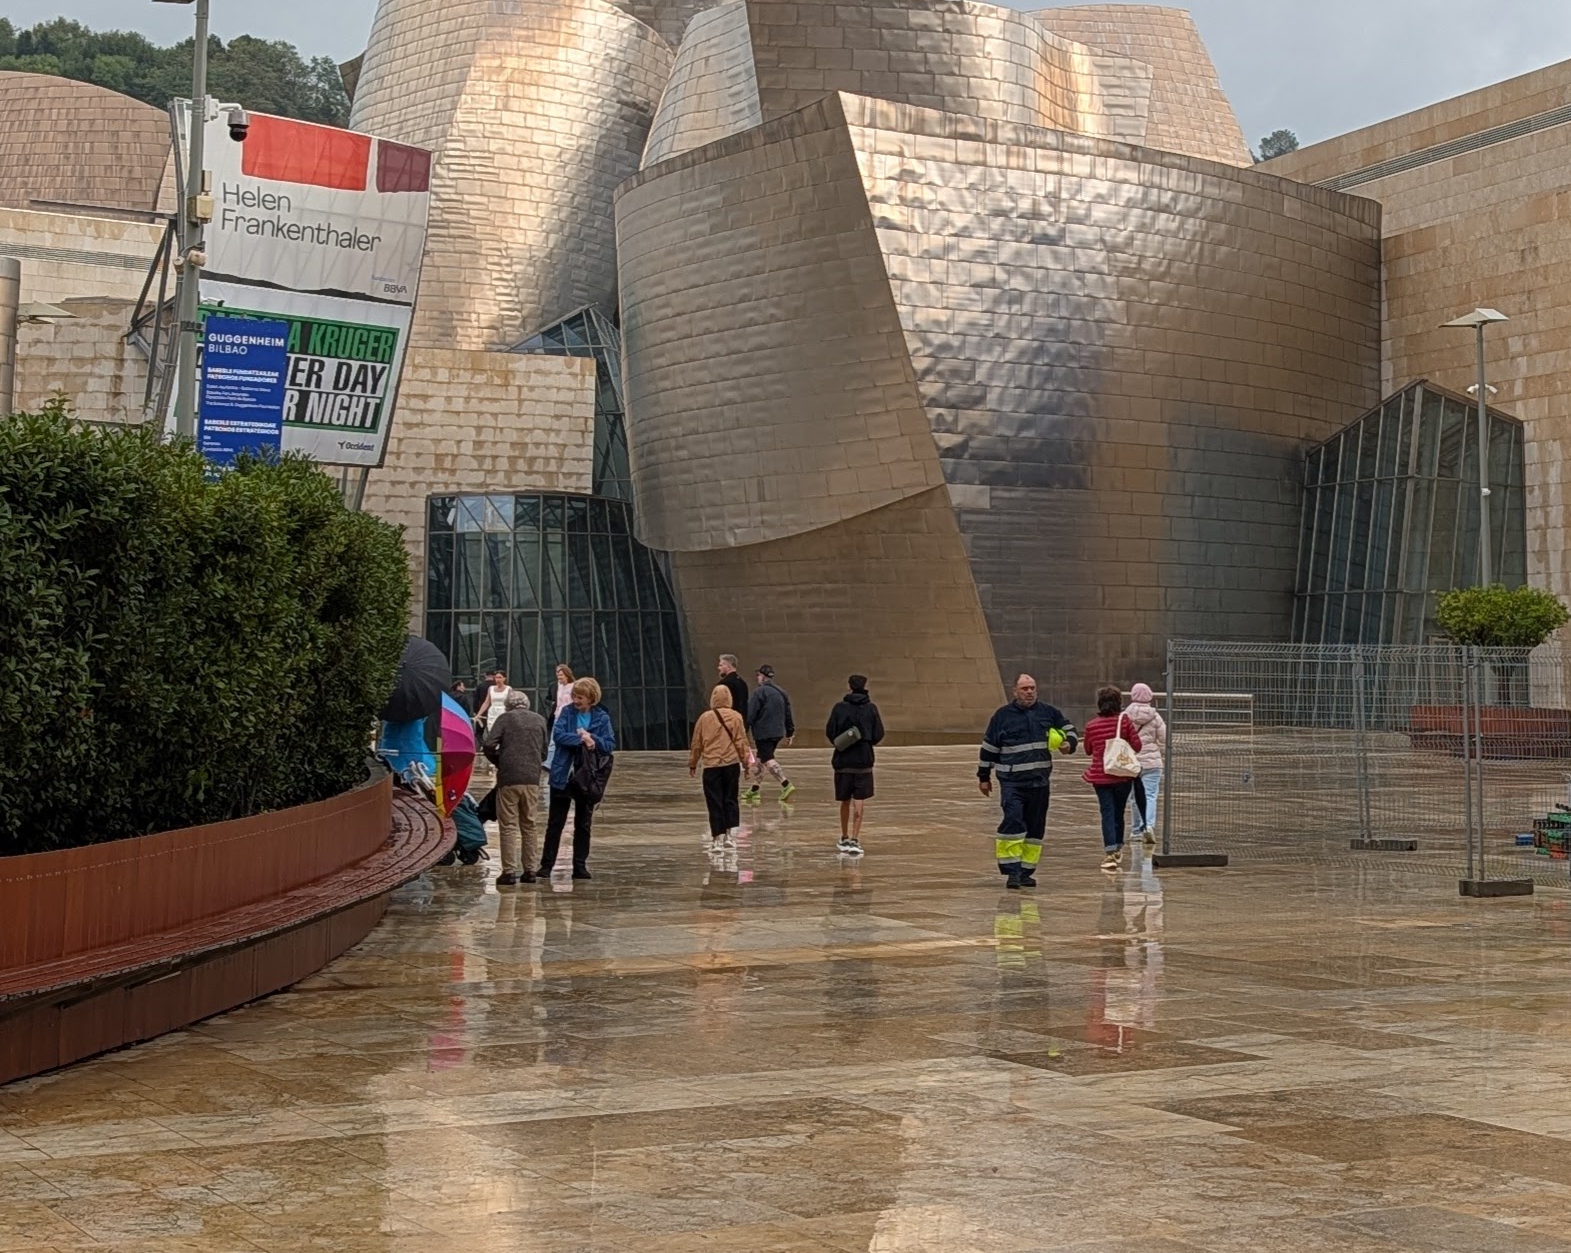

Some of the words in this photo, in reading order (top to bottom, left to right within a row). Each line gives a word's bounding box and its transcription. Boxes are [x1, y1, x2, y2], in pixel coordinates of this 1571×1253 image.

[222, 182, 291, 213] Helen
[221, 208, 382, 252] Frankenthaler
[383, 283, 408, 294] BBVA
[208, 333, 285, 347] GUGGENHEIM
[208, 343, 248, 355] BILBAO
[307, 323, 394, 362] KRUGER
[332, 360, 387, 395] DAY
[304, 394, 381, 428] NIGHT
[345, 441, 375, 451] Occident
